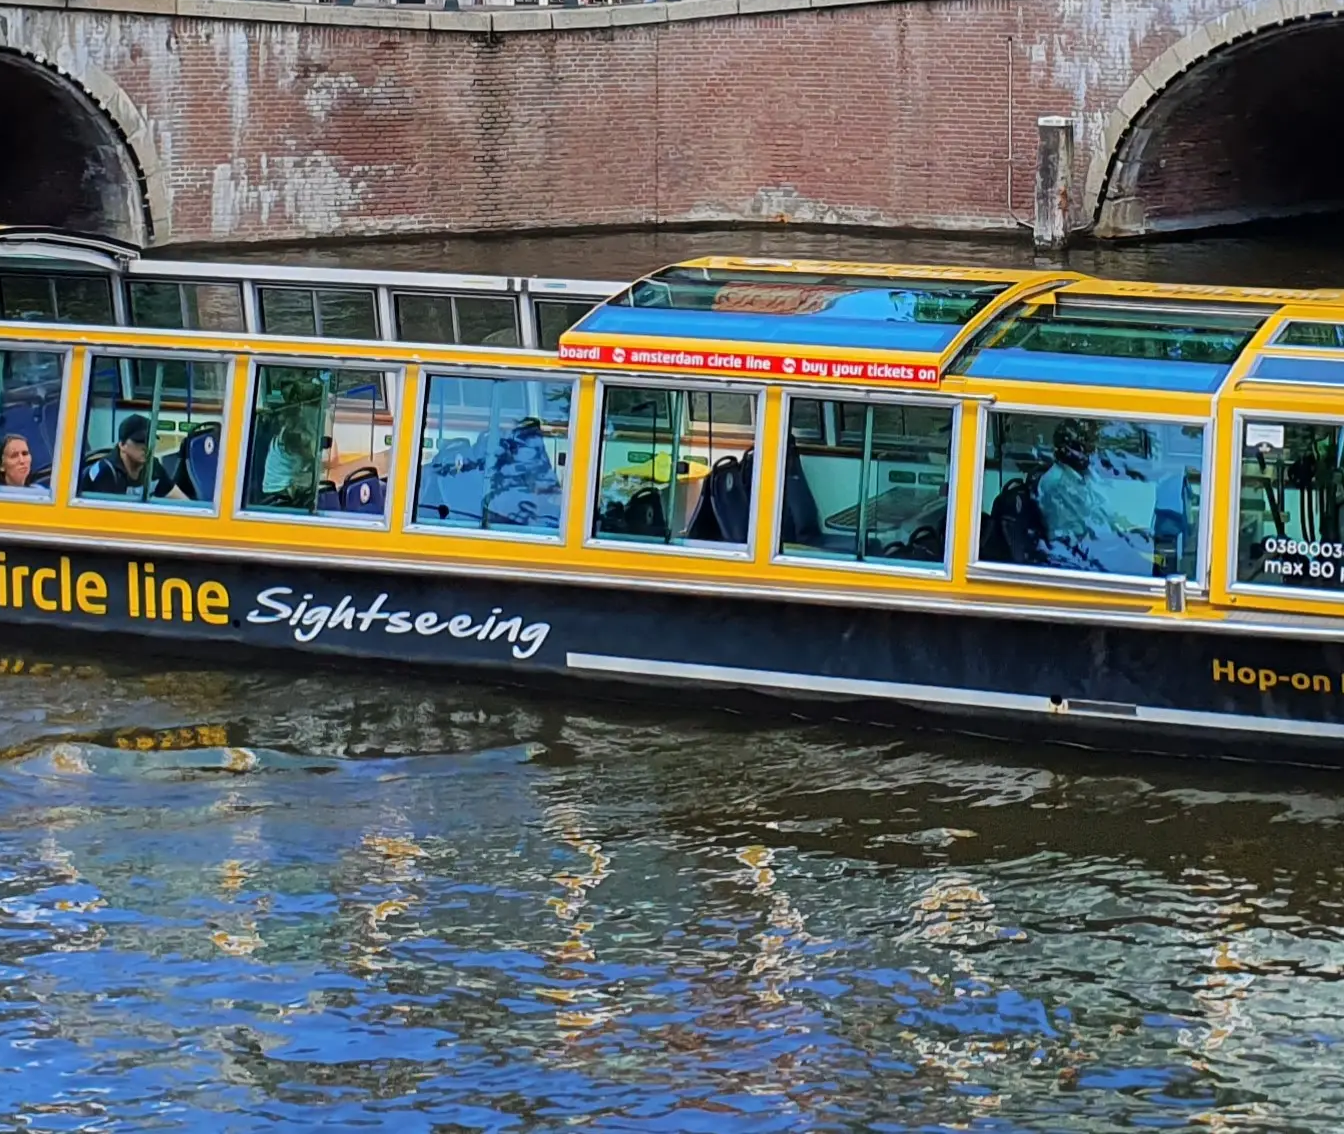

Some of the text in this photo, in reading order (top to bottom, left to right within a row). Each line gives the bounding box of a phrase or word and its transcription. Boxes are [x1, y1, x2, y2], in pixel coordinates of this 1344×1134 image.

[560, 346, 936, 381] board! amsterdam circle line buy your tickets on
[1264, 559, 1303, 576] max
[1309, 561, 1334, 578] 80
[128, 561, 230, 625] line
[246, 586, 551, 659] Sightseeing
[1212, 658, 1331, 692] Hop-on
